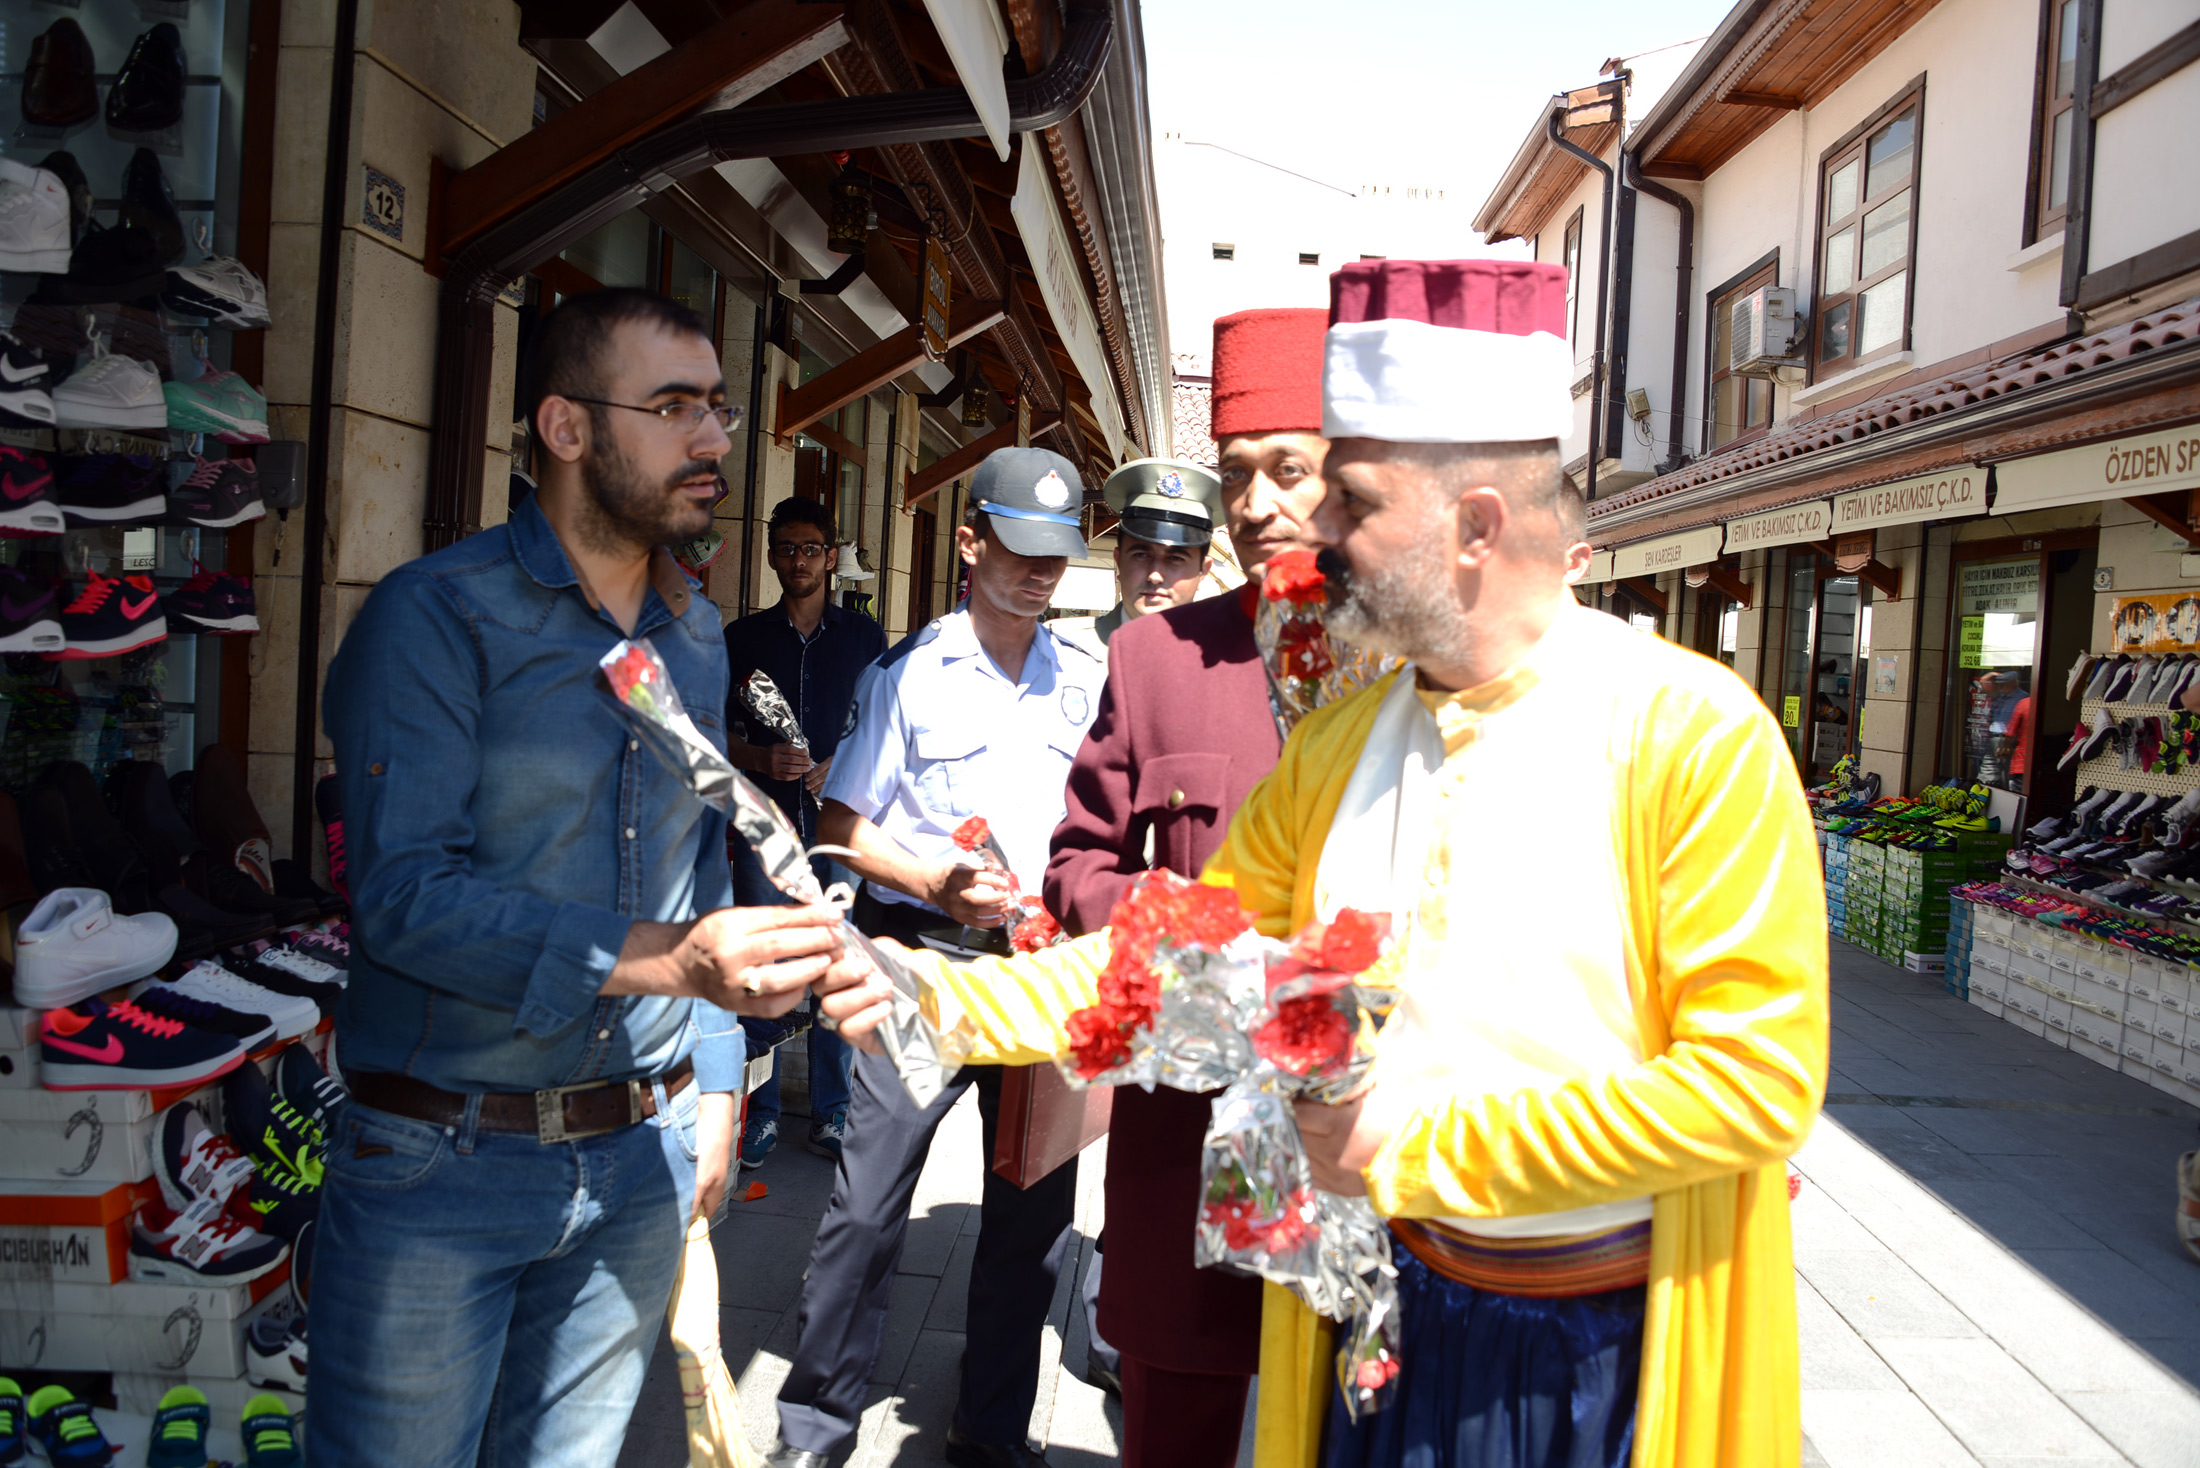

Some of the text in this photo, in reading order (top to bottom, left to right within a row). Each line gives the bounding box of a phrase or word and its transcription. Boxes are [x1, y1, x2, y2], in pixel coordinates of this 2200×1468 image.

[376, 191, 394, 220] 12
[2105, 439, 2200, 484] ÖZDEN SP
[1841, 477, 1972, 521] YETİM VE BAKIMSIZ Ç.K.D.
[1730, 511, 1821, 543] YETİM VE BAKIMSIZ Ç.K.D.
[1654, 545, 1681, 567] KARDEŞLER
[2099, 574, 2105, 584] 5
[1785, 710, 1794, 725] 20
